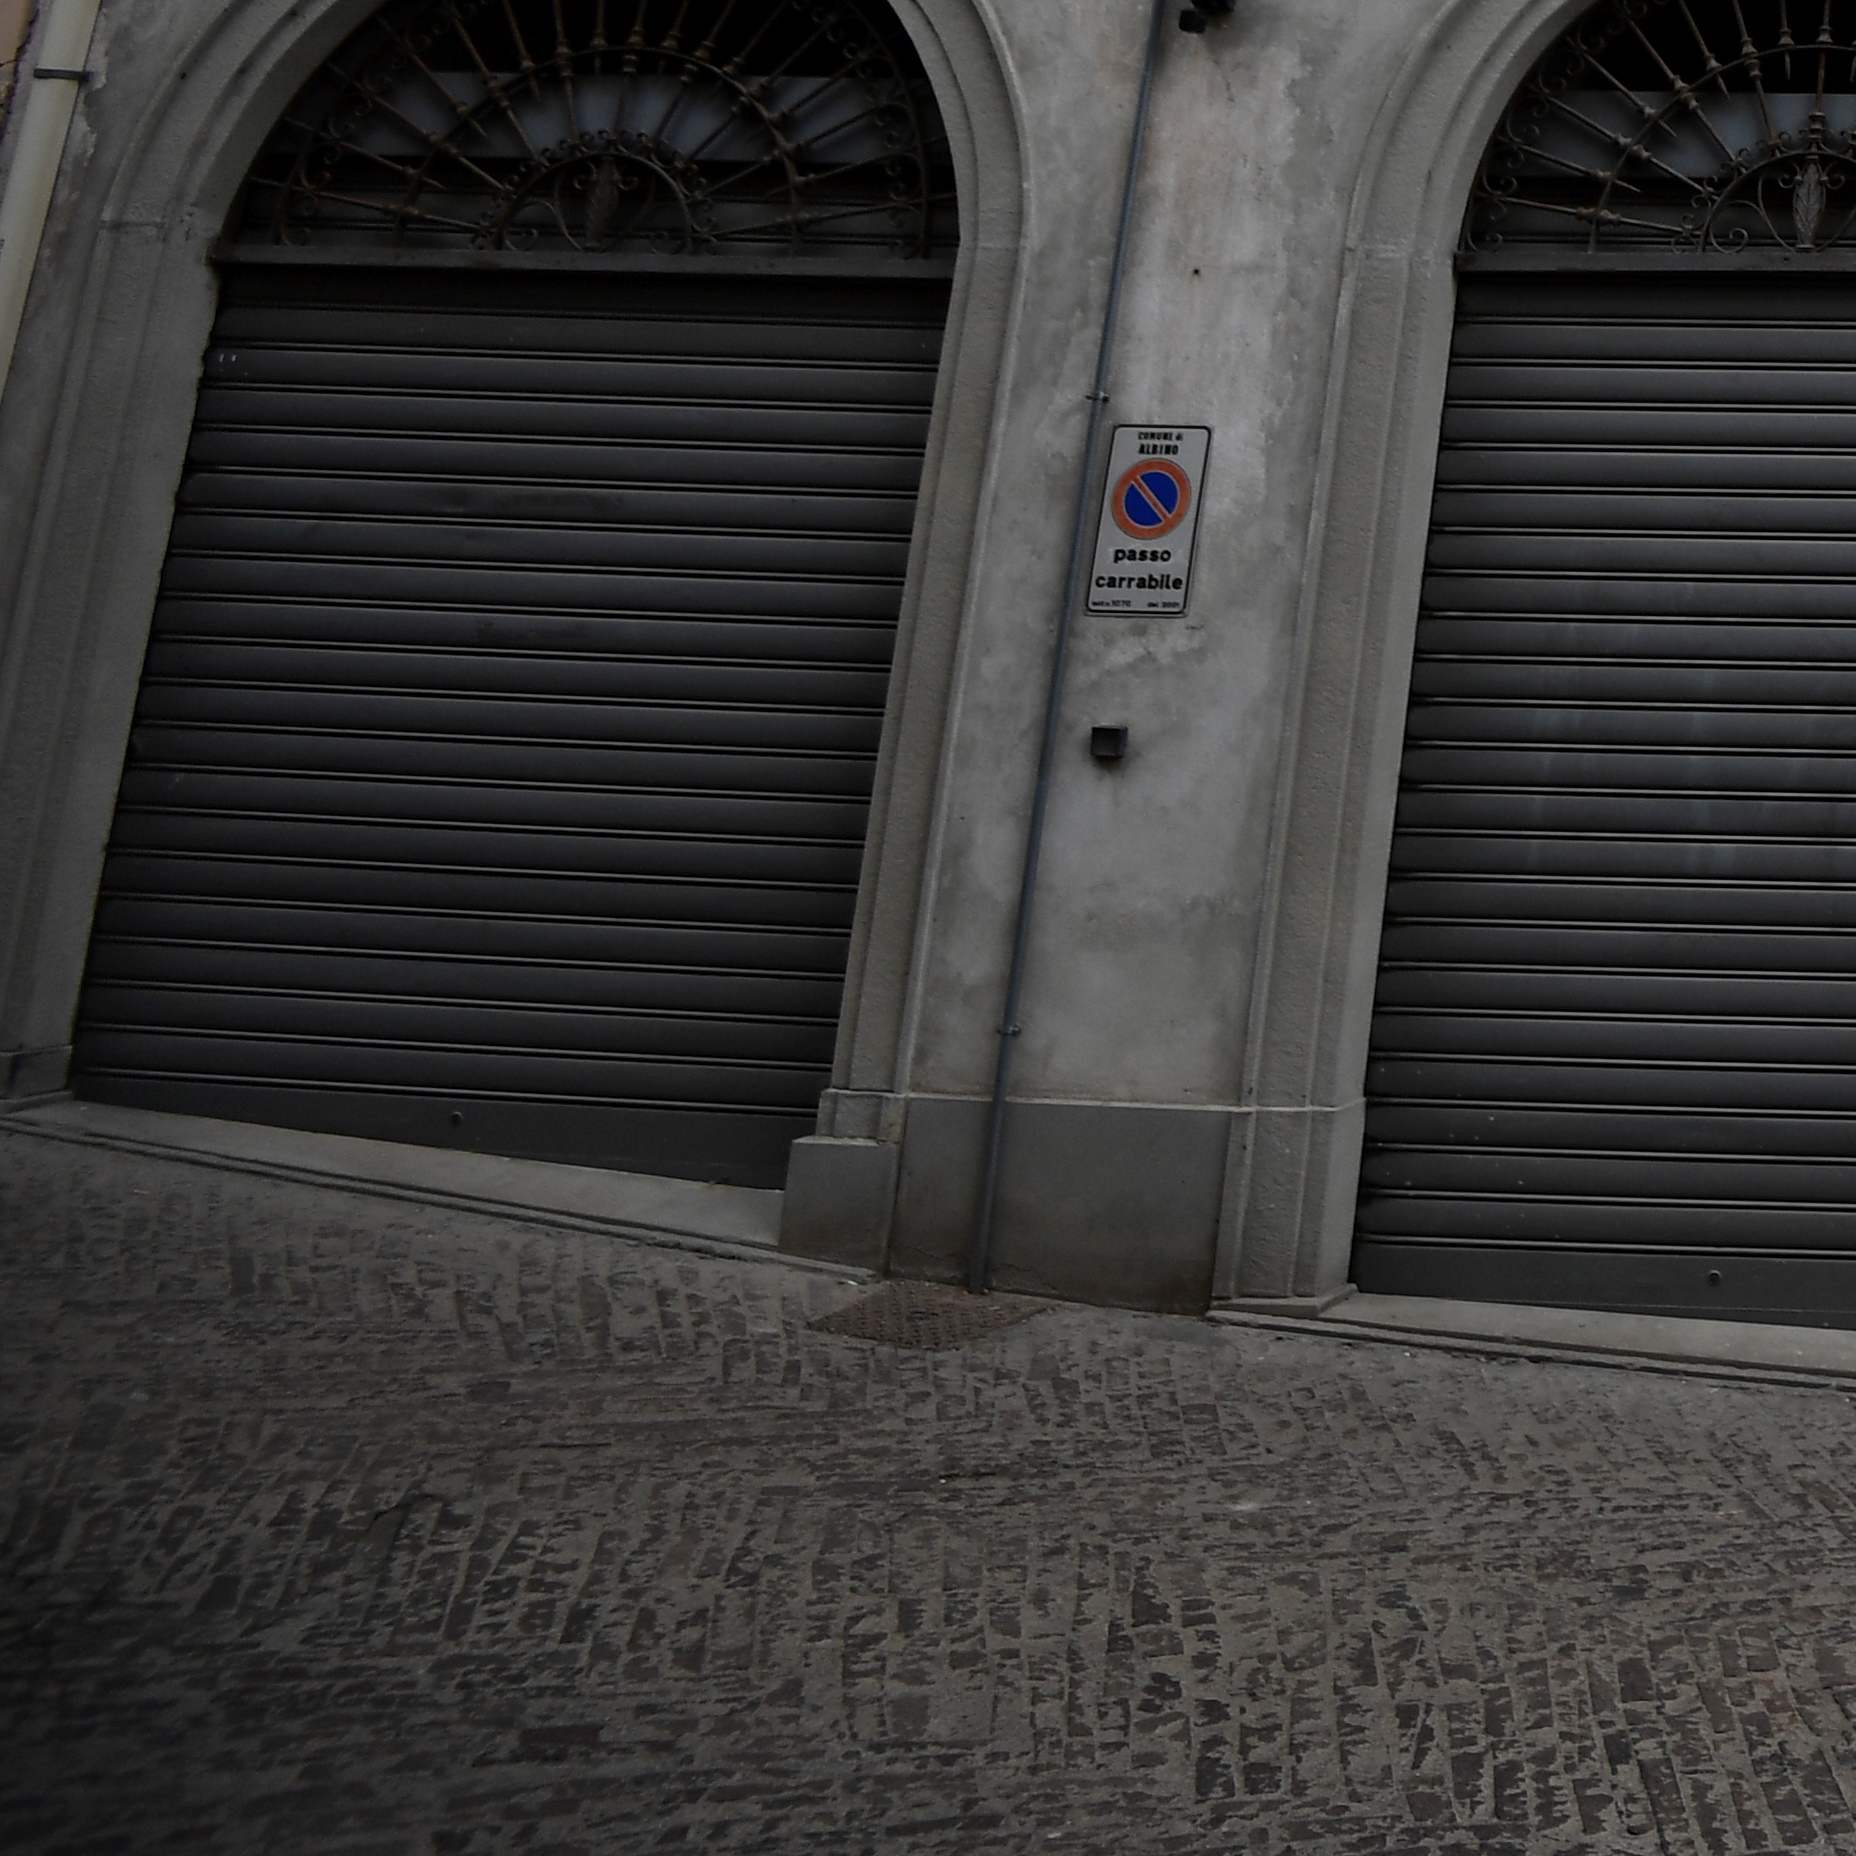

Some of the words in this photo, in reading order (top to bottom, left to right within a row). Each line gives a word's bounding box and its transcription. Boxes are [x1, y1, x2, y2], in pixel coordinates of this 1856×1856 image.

[1138, 444, 1179, 455] ALBINO
[1113, 549, 1172, 564] passo
[1095, 574, 1183, 590] carrabile
